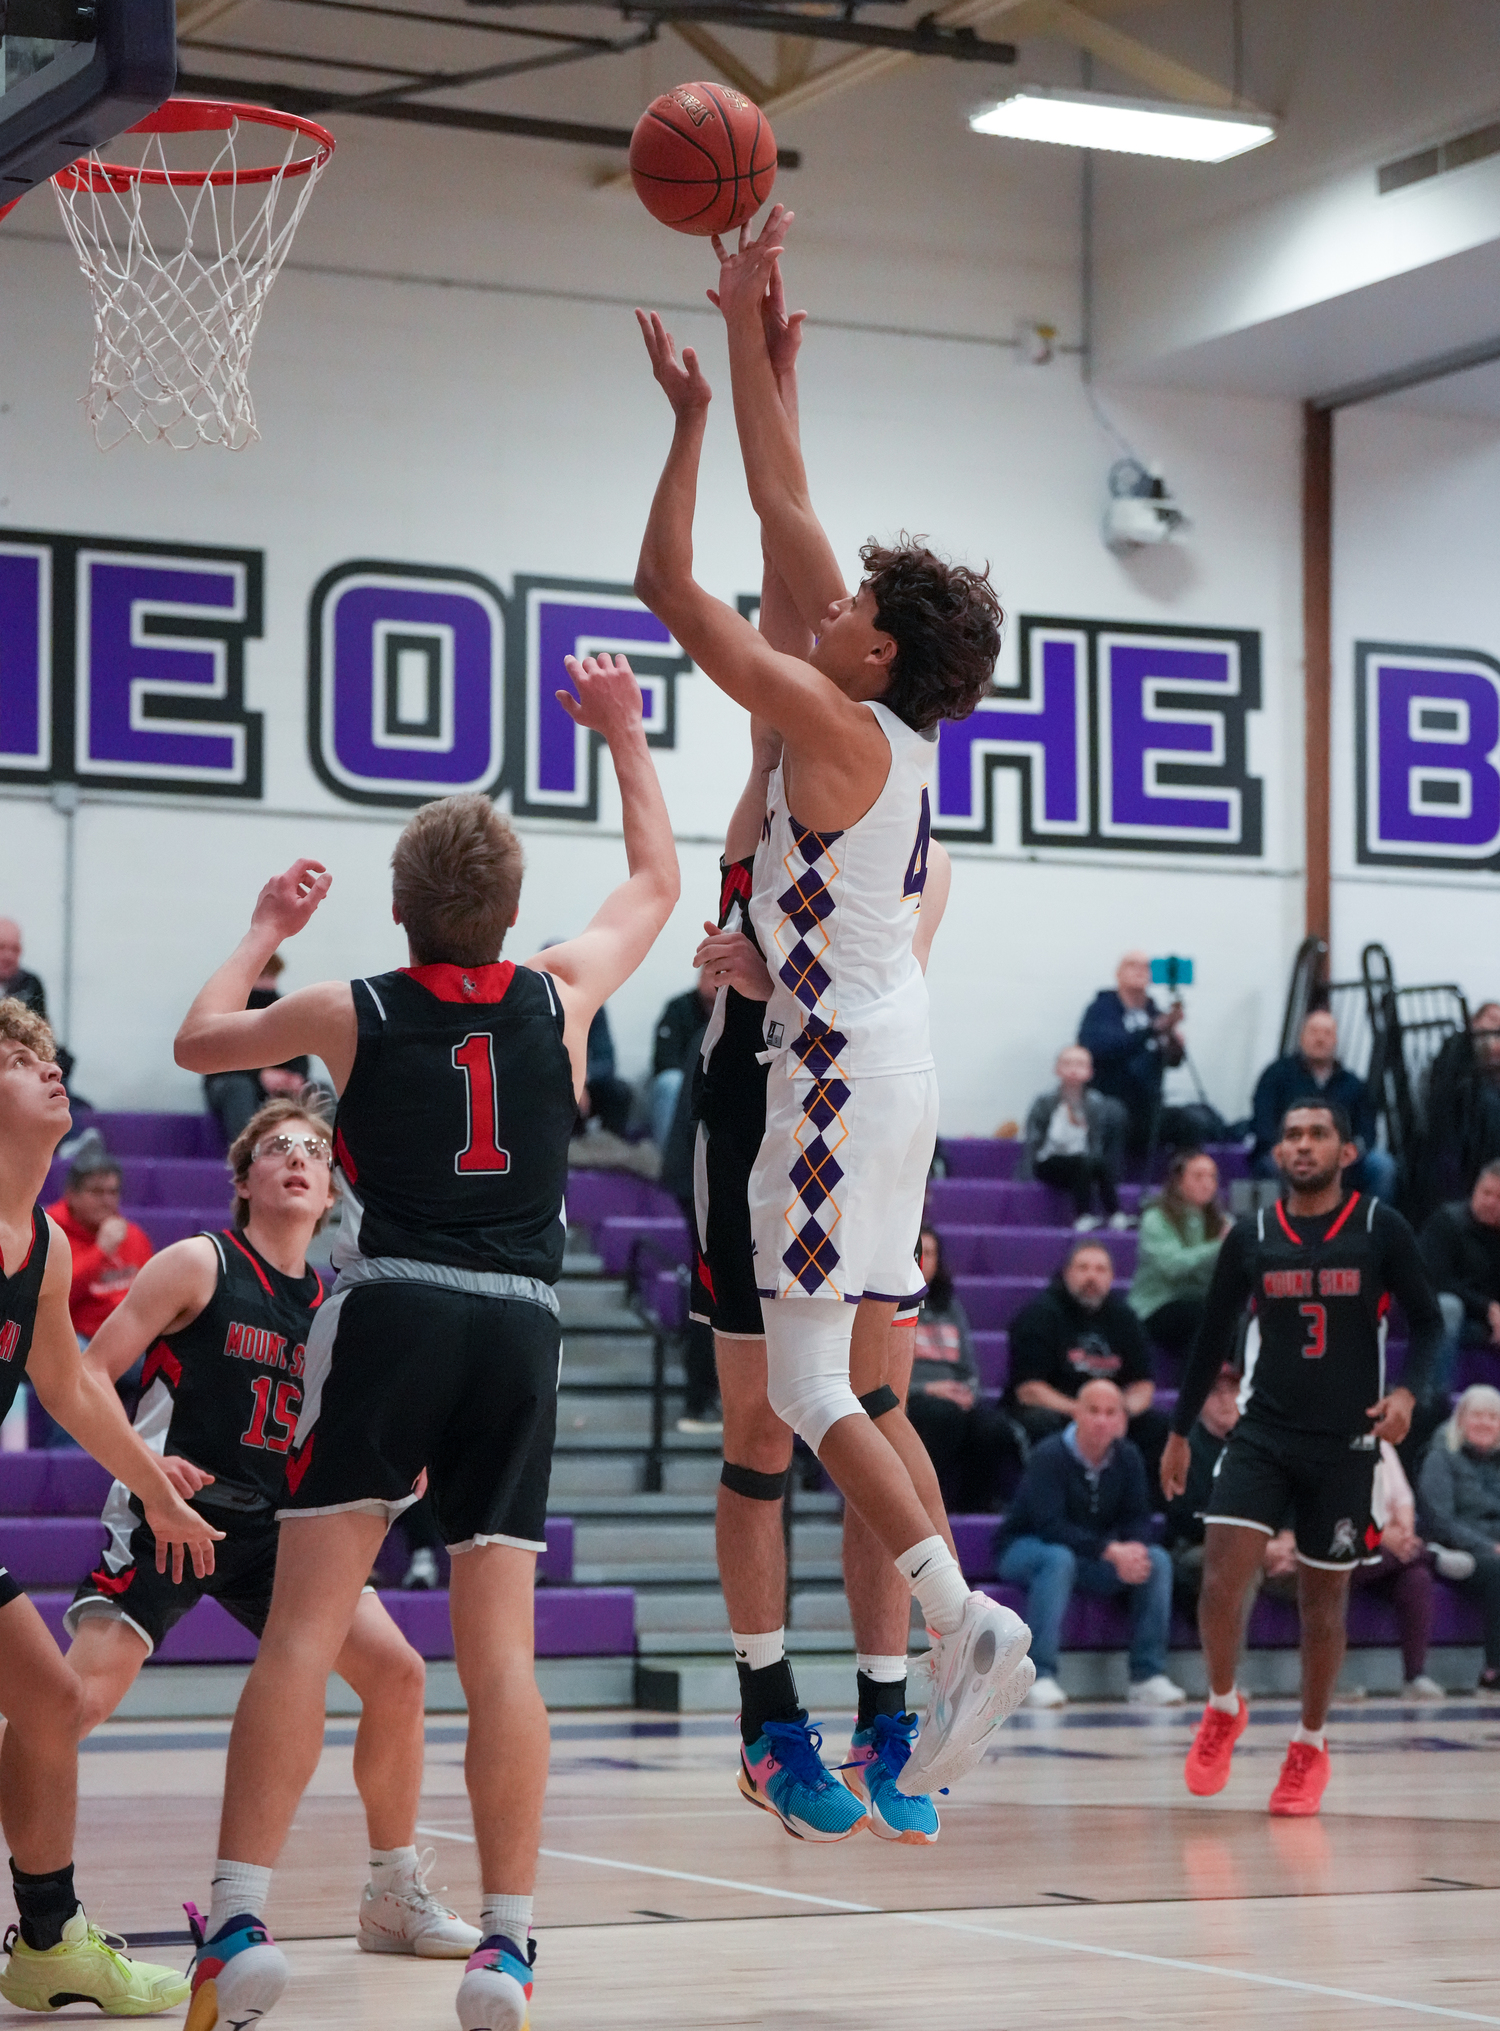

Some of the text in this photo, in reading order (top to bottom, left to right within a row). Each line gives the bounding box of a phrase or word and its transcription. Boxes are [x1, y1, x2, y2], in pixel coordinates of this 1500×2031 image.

[309, 558, 693, 822] OF
[736, 594, 1263, 858] HE
[1354, 639, 1500, 869] B
[900, 782, 931, 915] 4
[452, 1032, 510, 1175] 1
[223, 1320, 288, 1370] MOUNT
[1300, 1302, 1327, 1358] 3
[240, 1375, 304, 1455] 15
